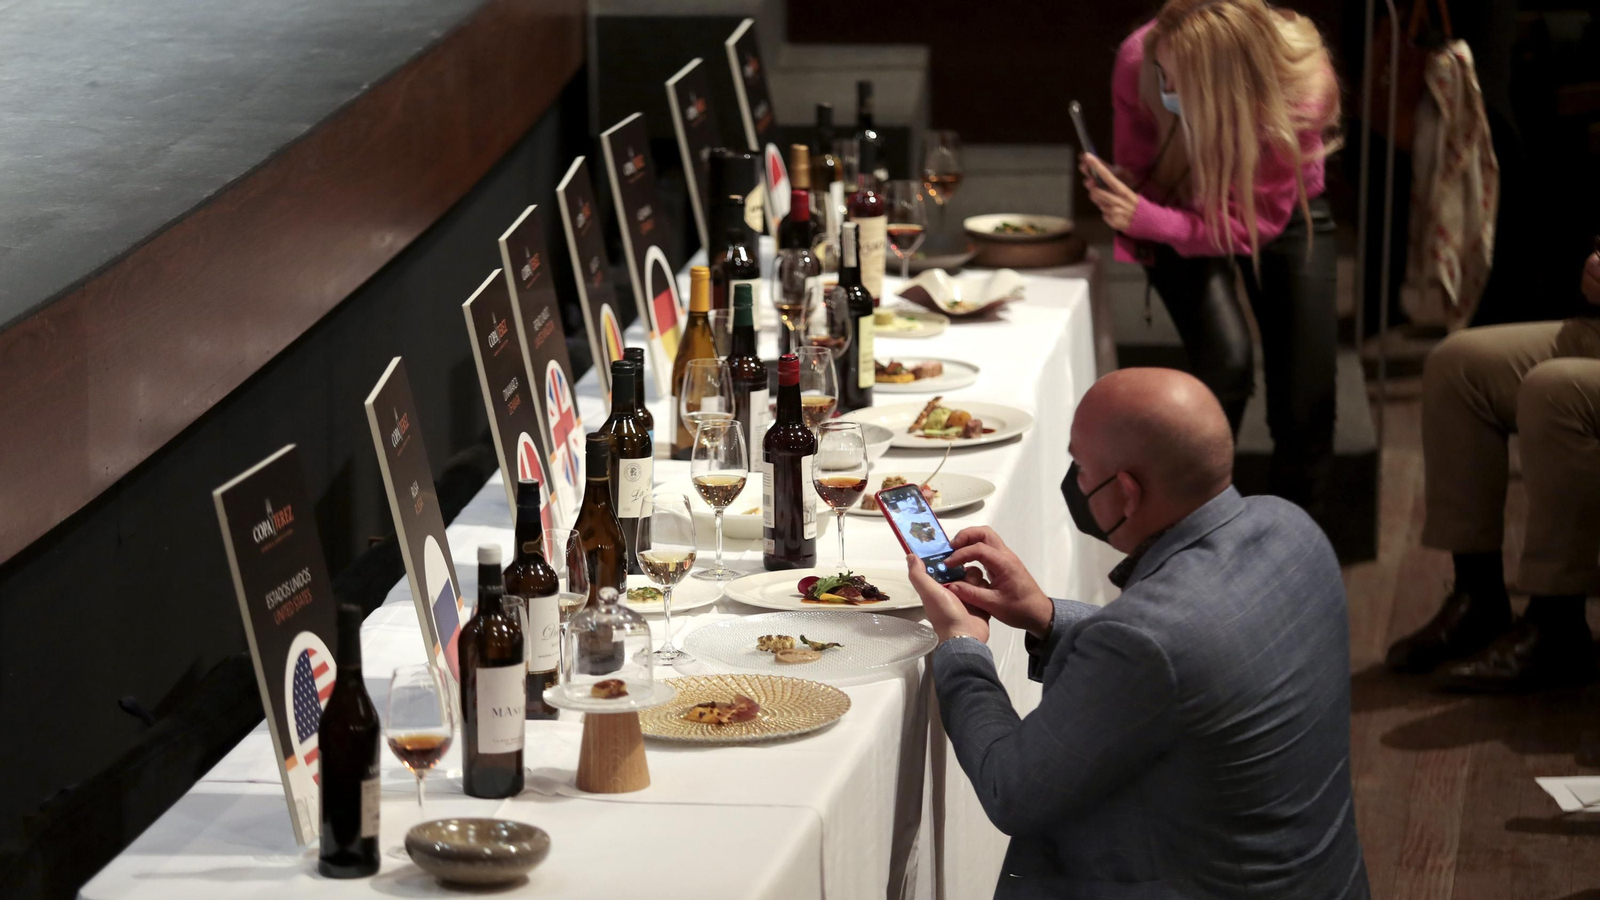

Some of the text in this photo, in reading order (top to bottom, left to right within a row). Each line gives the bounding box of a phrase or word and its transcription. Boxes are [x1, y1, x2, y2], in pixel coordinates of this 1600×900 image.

[488, 329, 500, 348] COPA
[253, 520, 274, 542] COPA
[274, 505, 294, 530] JEREZ
[265, 567, 311, 609] ESTADOS UNIDOS
[274, 588, 312, 625] UNITED STATES
